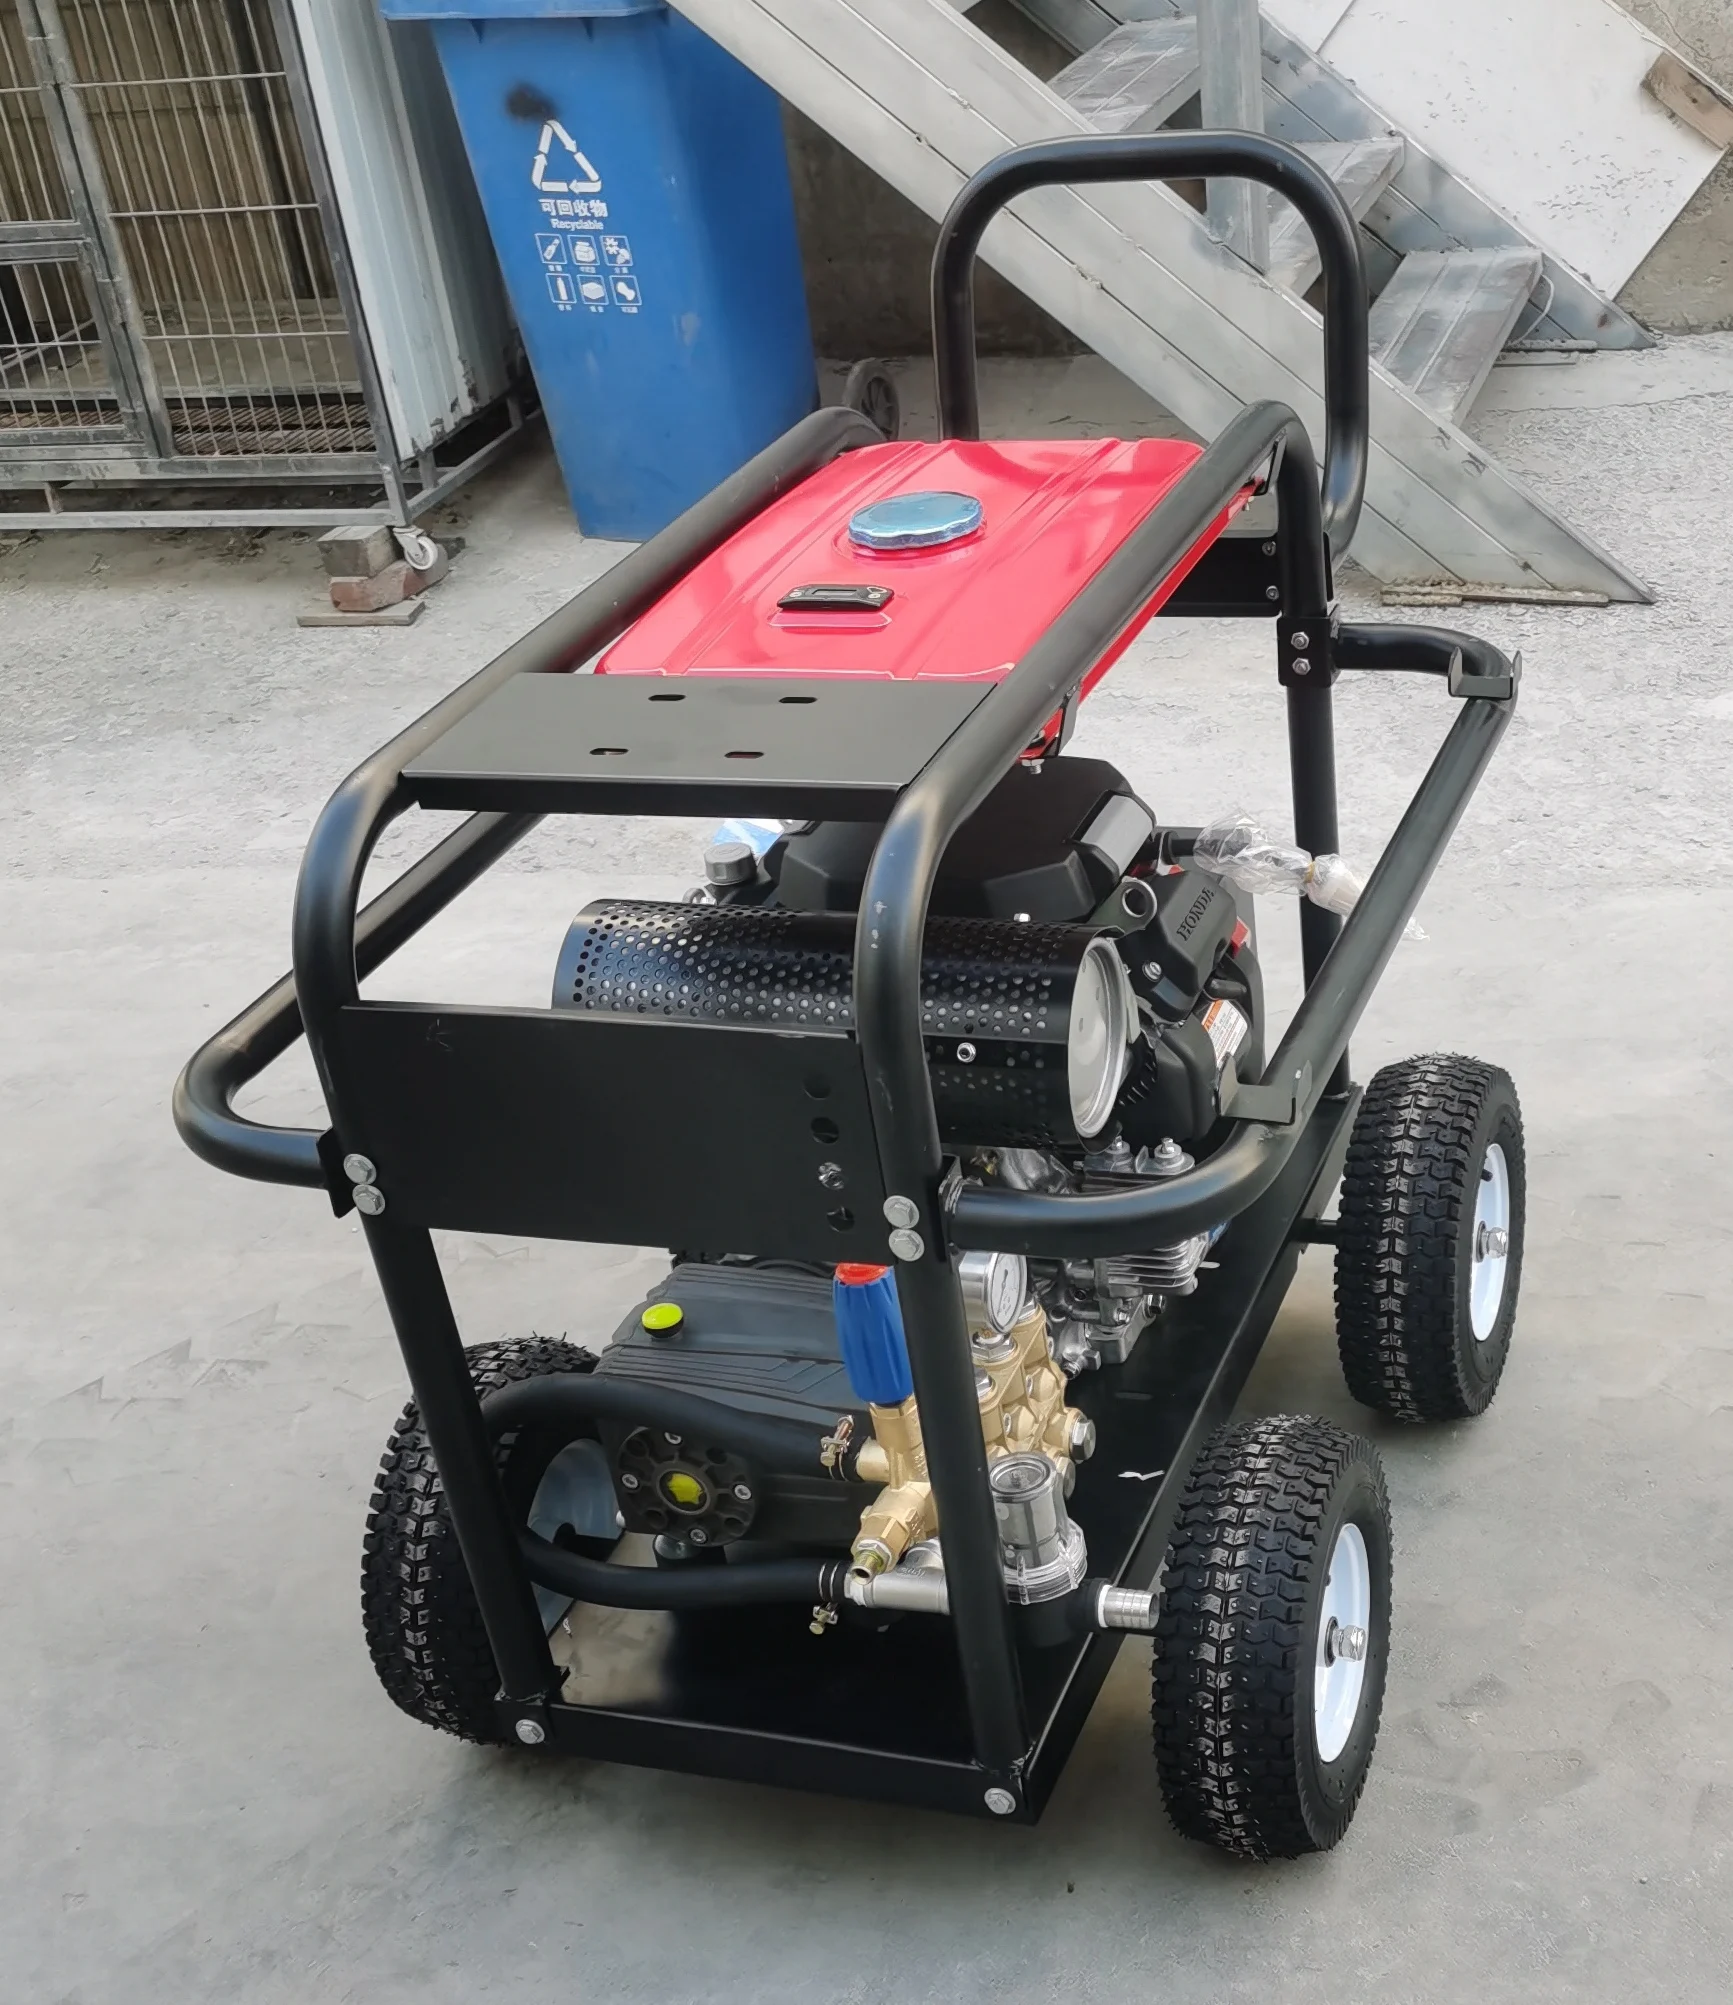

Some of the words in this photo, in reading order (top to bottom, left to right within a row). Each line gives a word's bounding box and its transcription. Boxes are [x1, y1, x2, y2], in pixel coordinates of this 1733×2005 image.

[538, 199, 608, 217] 可回收物
[550, 218, 604, 231] Recyclable
[1176, 887, 1215, 942] HONDA
